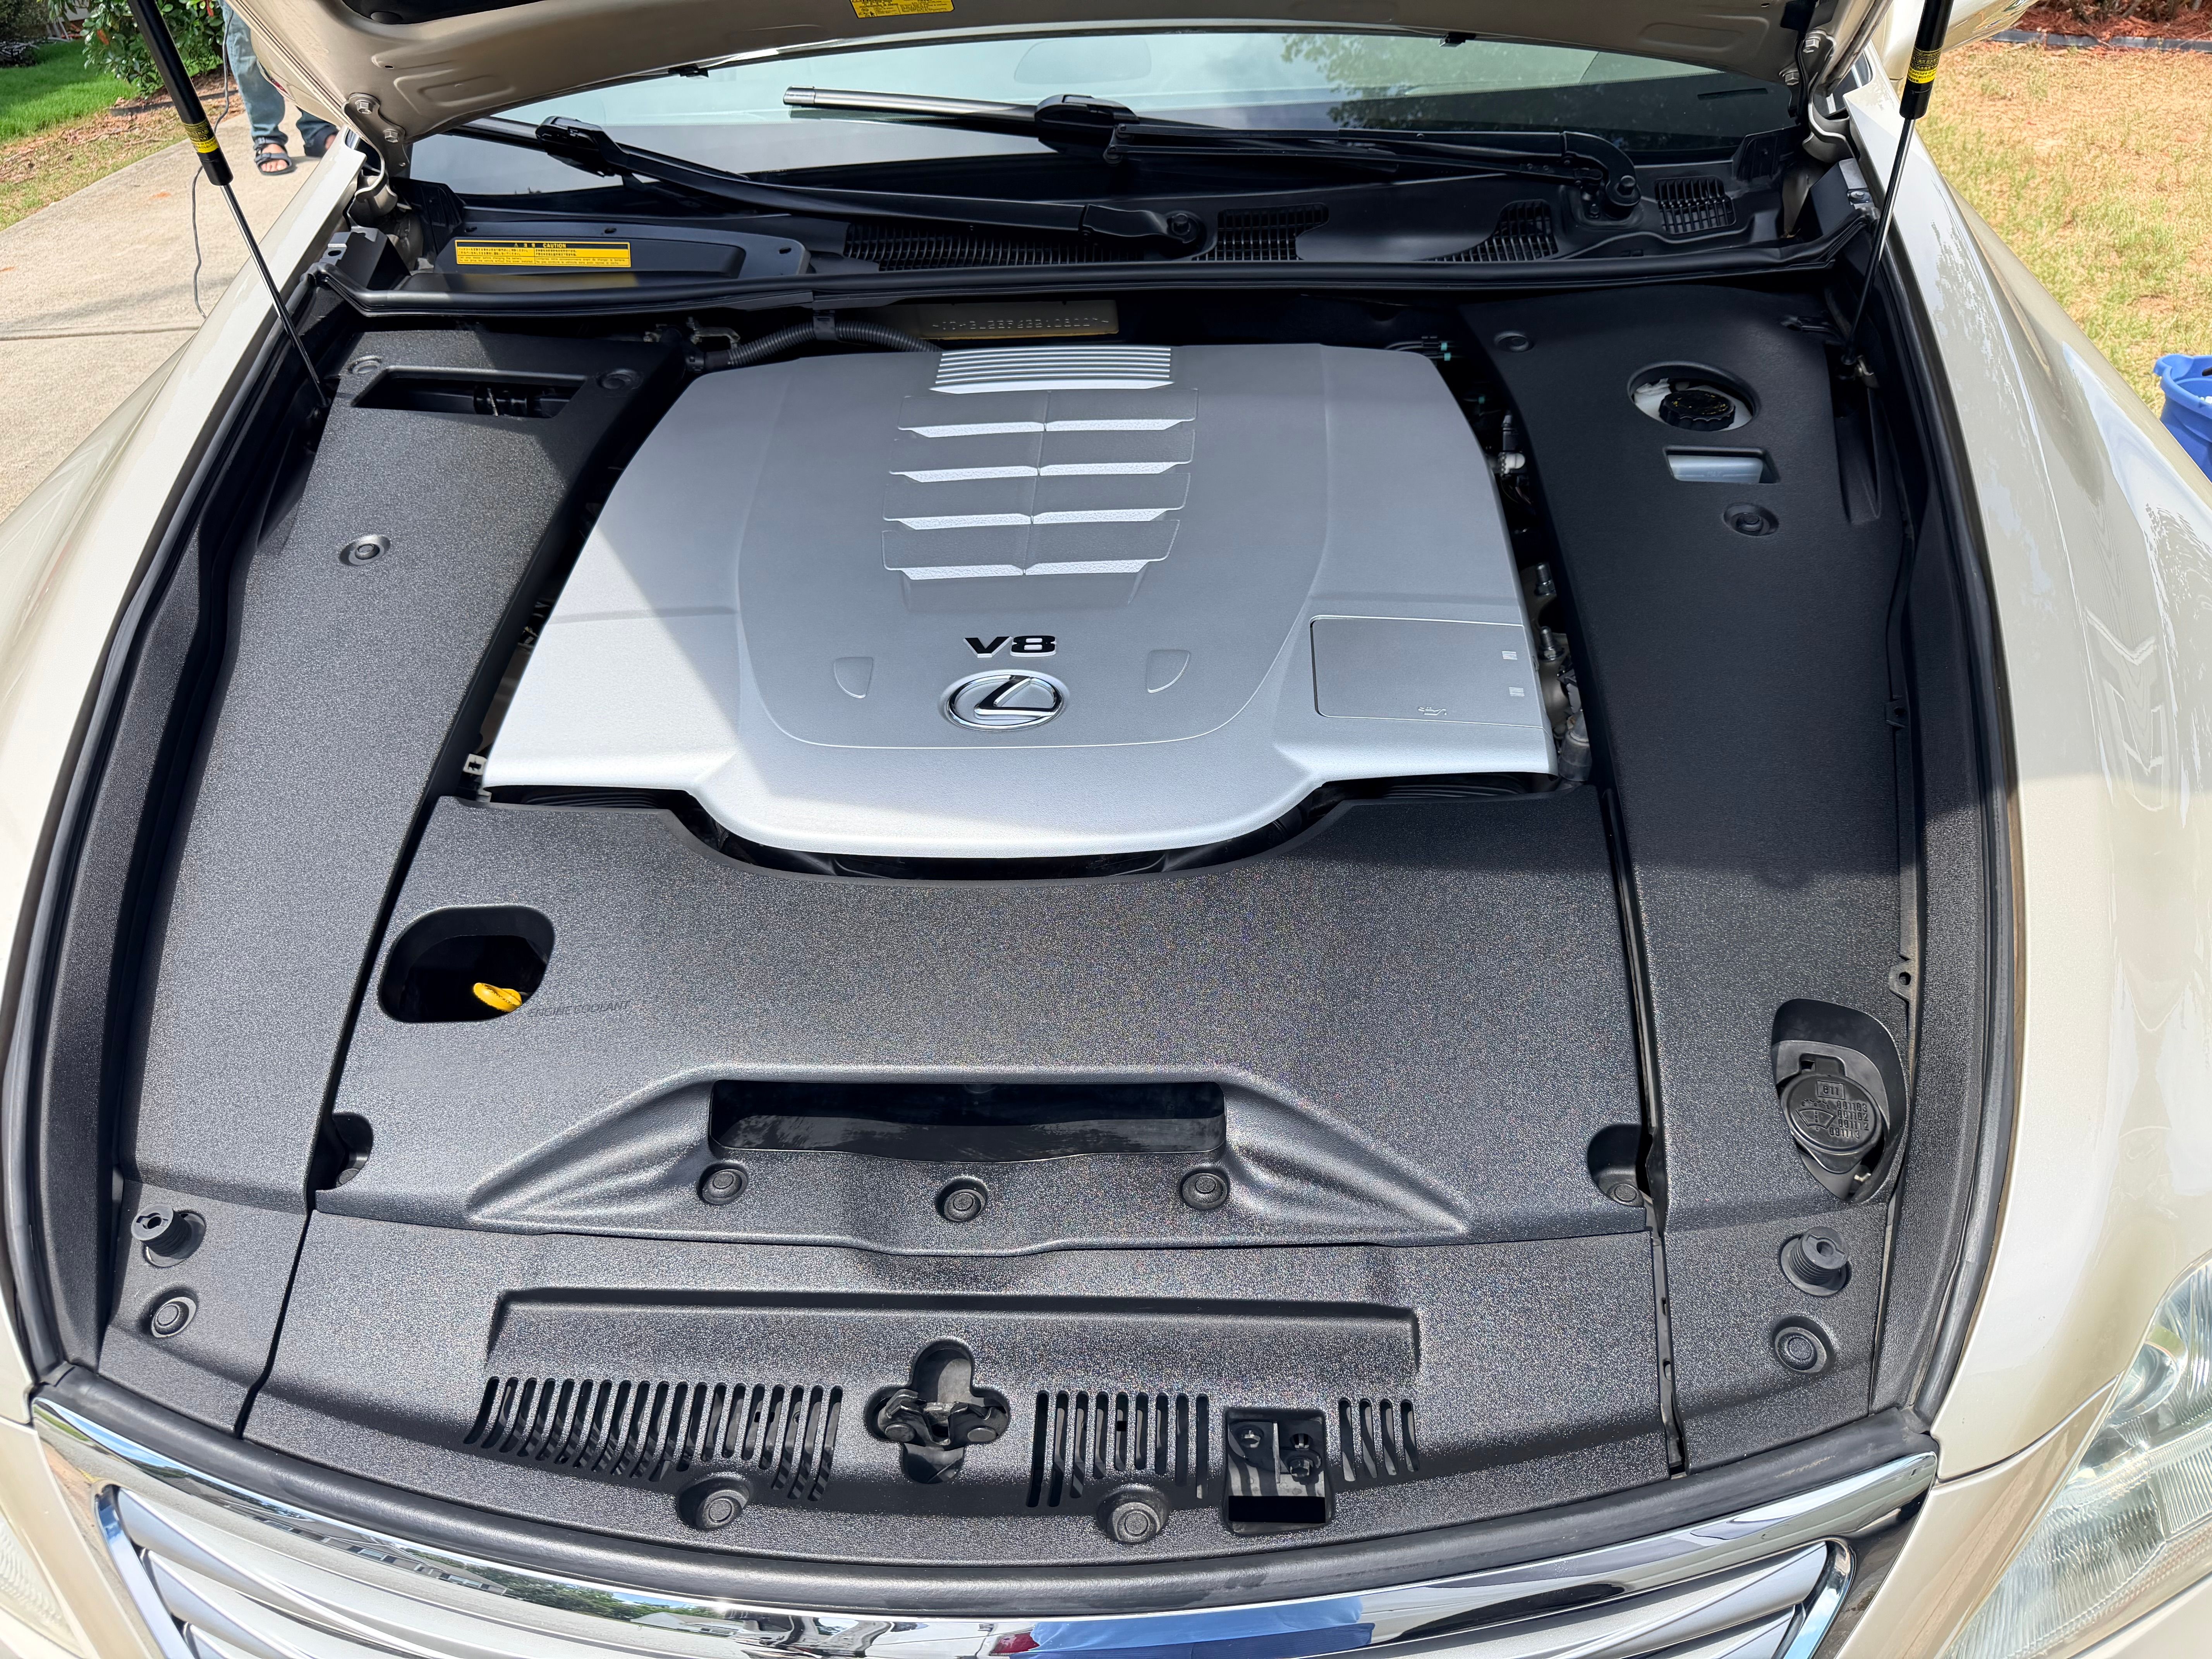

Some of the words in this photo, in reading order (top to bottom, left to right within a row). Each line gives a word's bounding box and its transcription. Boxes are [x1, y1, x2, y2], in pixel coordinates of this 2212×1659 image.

[963, 635, 1057, 658] V8
[528, 1005, 572, 1017] ENGINE
[574, 1001, 630, 1013] COOLANT
